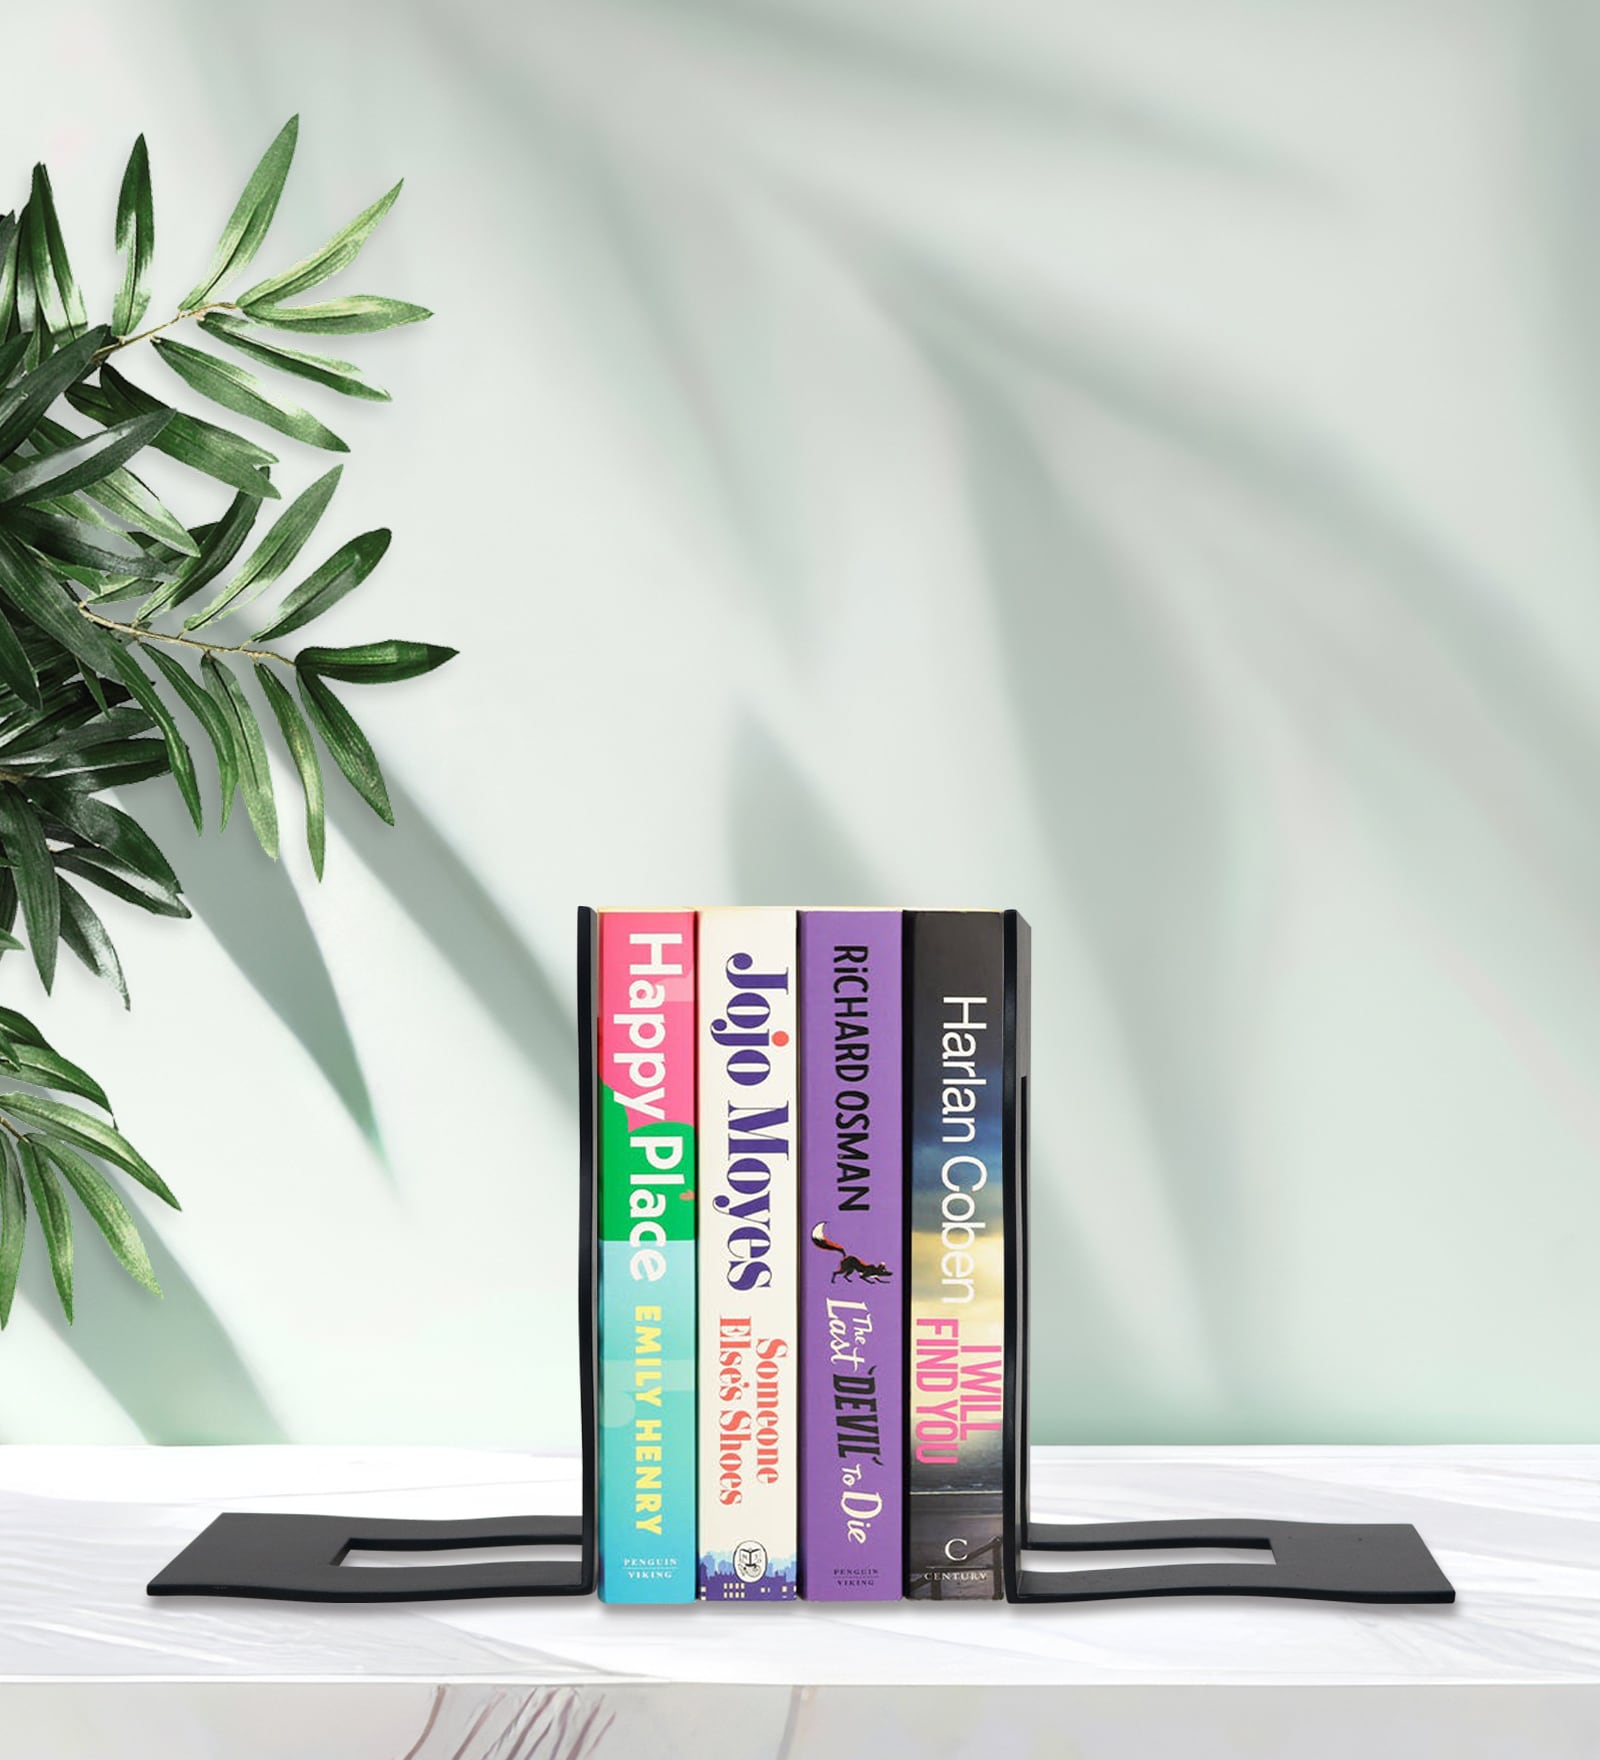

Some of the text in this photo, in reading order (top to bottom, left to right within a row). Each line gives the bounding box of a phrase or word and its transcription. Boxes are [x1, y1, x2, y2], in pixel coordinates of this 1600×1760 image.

[613, 933, 685, 1282] Happy Place
[710, 952, 789, 1291] Jojo Moyes
[835, 1090, 870, 1211] OSMAN
[940, 996, 988, 1304] Harlan Coben
[826, 1297, 867, 1372] Last
[852, 1313, 873, 1345] The
[634, 1305, 662, 1536] EMILY HENRY
[719, 1315, 752, 1506] Else's Shoes
[756, 1338, 789, 1484] Someone
[915, 1318, 959, 1464] FIND YOU
[960, 1345, 1002, 1441] I WILL
[840, 1463, 883, 1544] To Die
[623, 1557, 678, 1567] PENGUIN
[627, 1571, 673, 1579] VIKING
[833, 1568, 879, 1576] PENGUIN
[837, 1579, 875, 1587] VIKING
[924, 1571, 988, 1581] CENTURY
[944, 1539, 968, 1561] C
